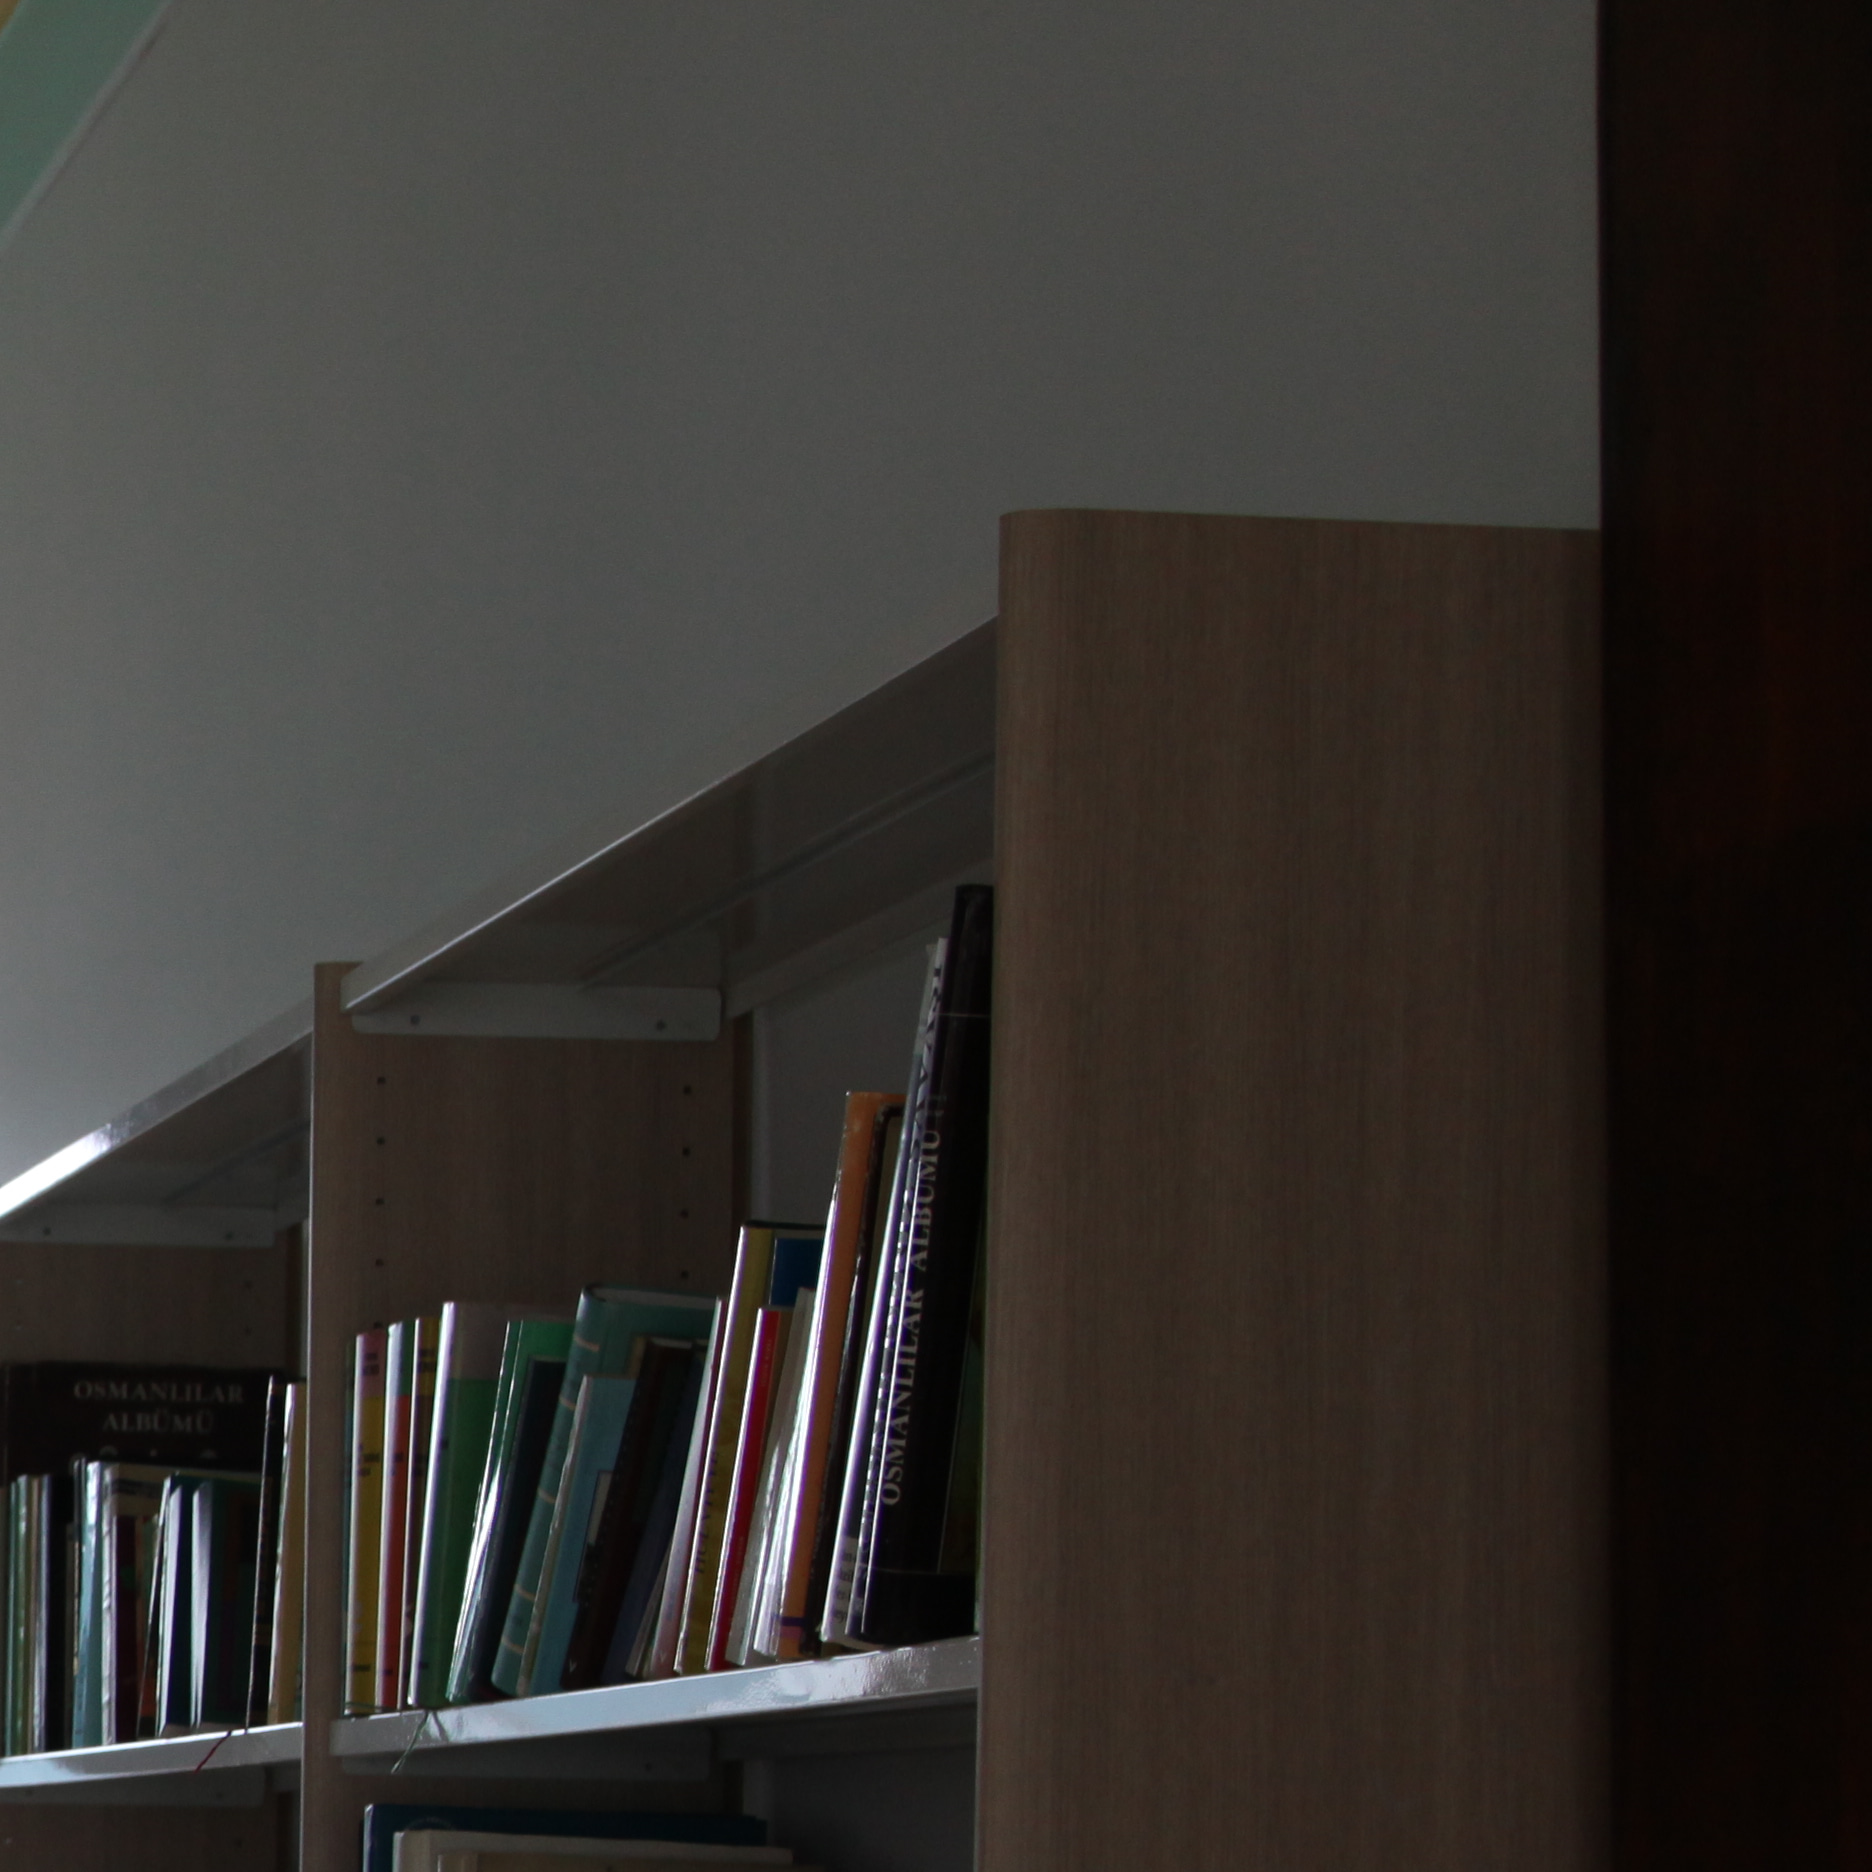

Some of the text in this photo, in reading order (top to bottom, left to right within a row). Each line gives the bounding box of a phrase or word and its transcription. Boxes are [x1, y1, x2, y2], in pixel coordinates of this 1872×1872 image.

[73, 1379, 244, 1404] OSMANLILAR
[878, 1288, 928, 1507] OSMANLILAR
[102, 1408, 215, 1434] ALBÜMÜ
